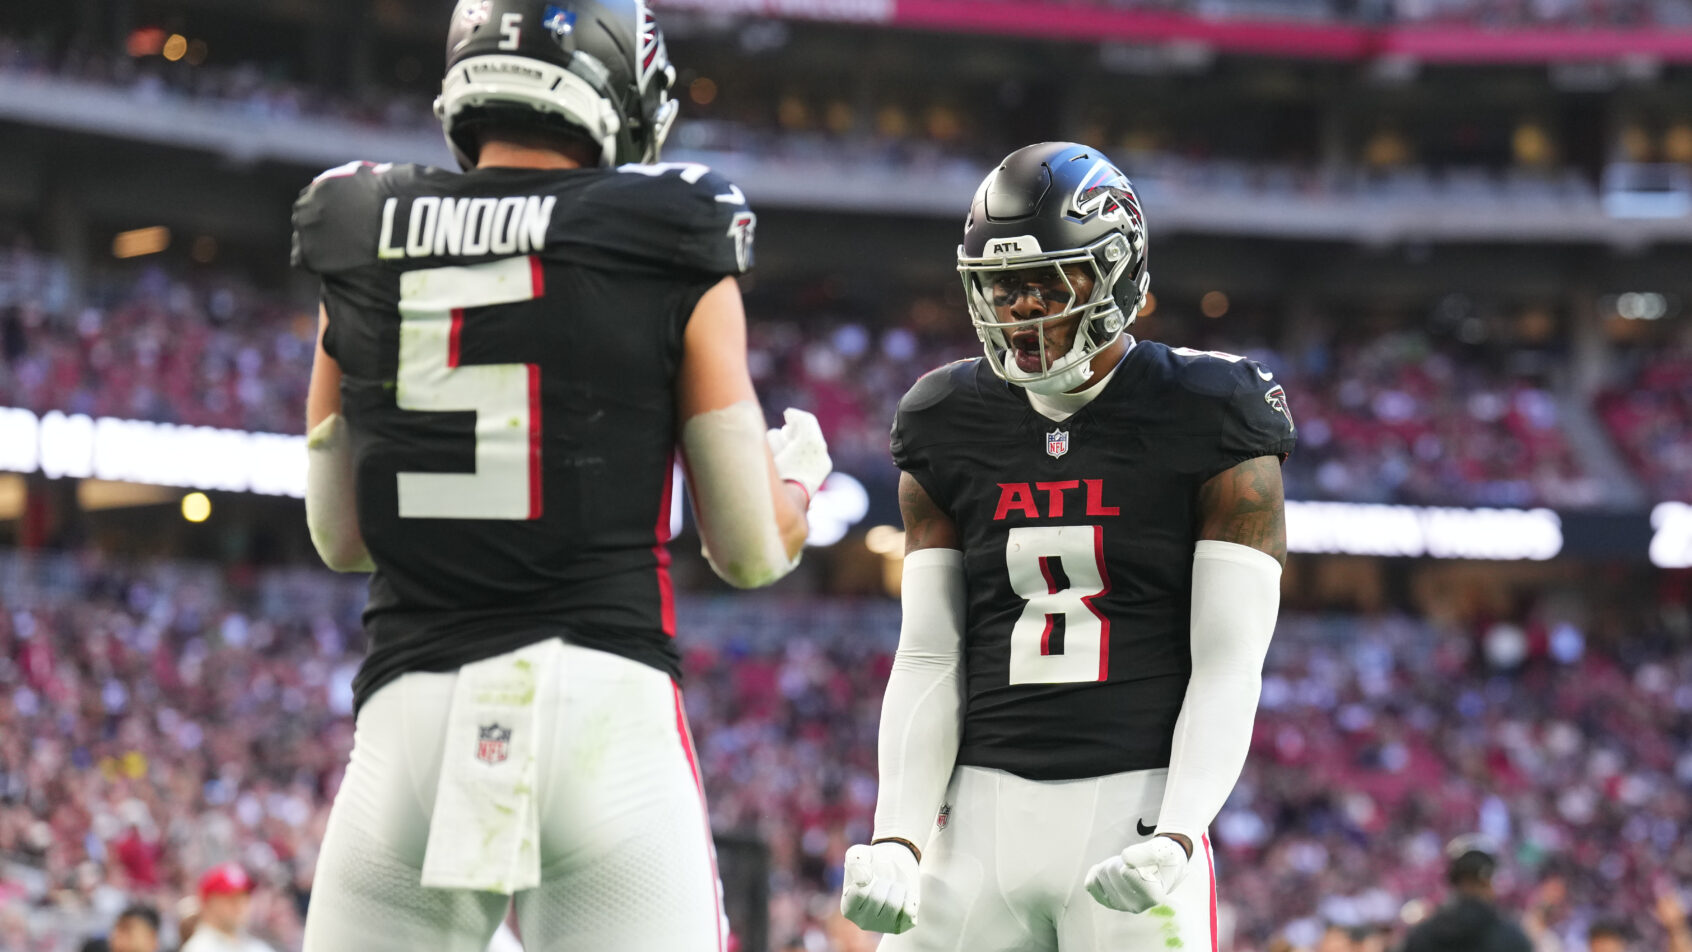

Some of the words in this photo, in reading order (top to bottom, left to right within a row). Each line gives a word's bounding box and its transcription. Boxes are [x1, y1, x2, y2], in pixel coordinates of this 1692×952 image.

[498, 12, 523, 51] 5
[378, 195, 557, 259] LONDON
[993, 242, 1022, 254] ATL
[396, 255, 545, 520] 5
[1049, 441, 1065, 454] NFL
[993, 479, 1120, 520] ATL
[1006, 525, 1112, 685] 8
[477, 740, 508, 762] NFL
